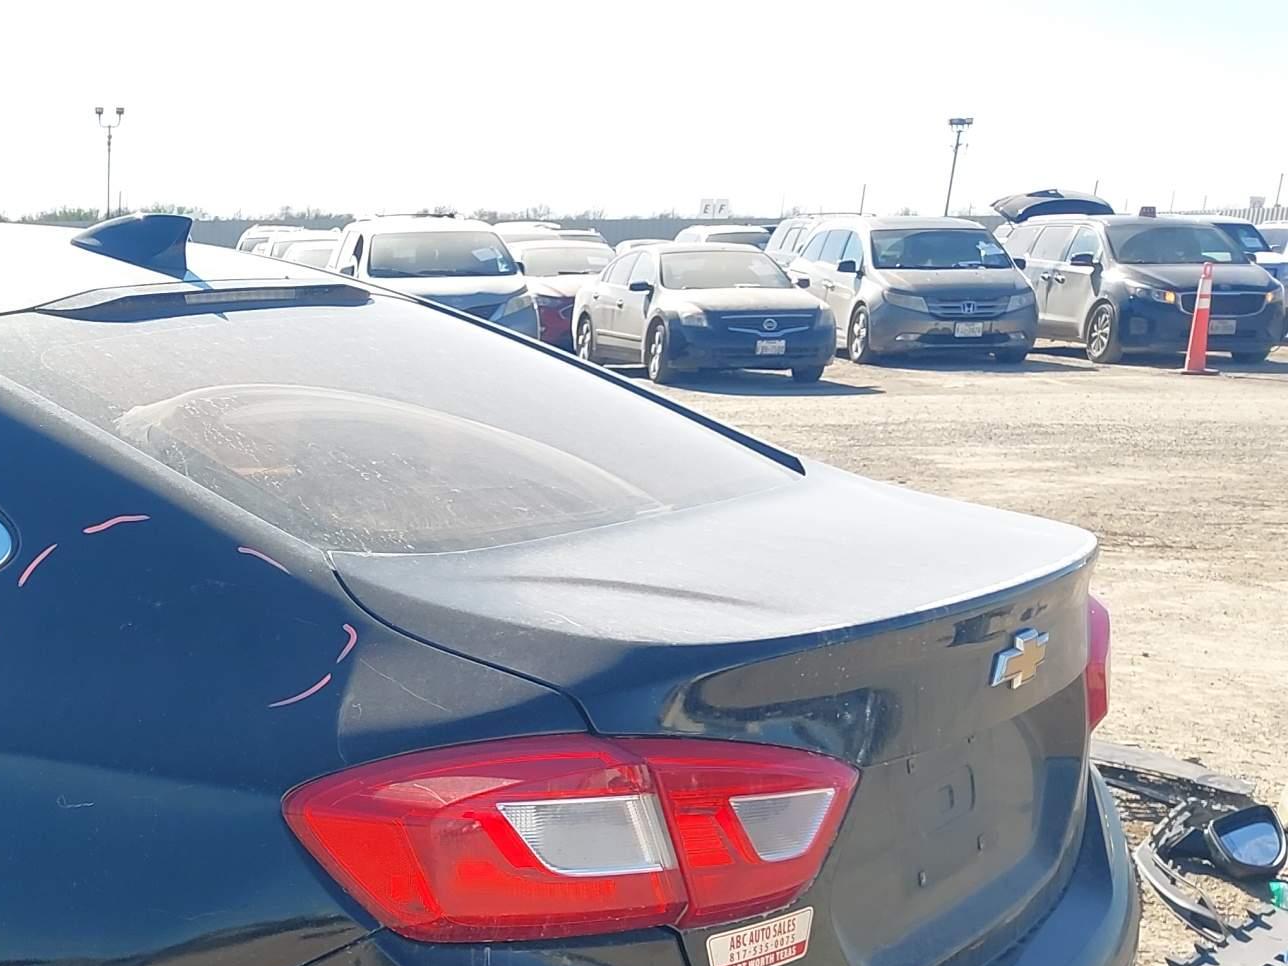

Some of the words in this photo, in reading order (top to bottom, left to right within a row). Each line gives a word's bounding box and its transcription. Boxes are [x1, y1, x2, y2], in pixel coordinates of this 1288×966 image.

[703, 203, 711, 214] E
[718, 203, 726, 214] F
[729, 935, 747, 951] ABC
[748, 925, 771, 944] AUTO
[772, 918, 796, 938] SALES
[729, 934, 795, 962] 817-535-0075
[775, 946, 797, 961] TEXAS
